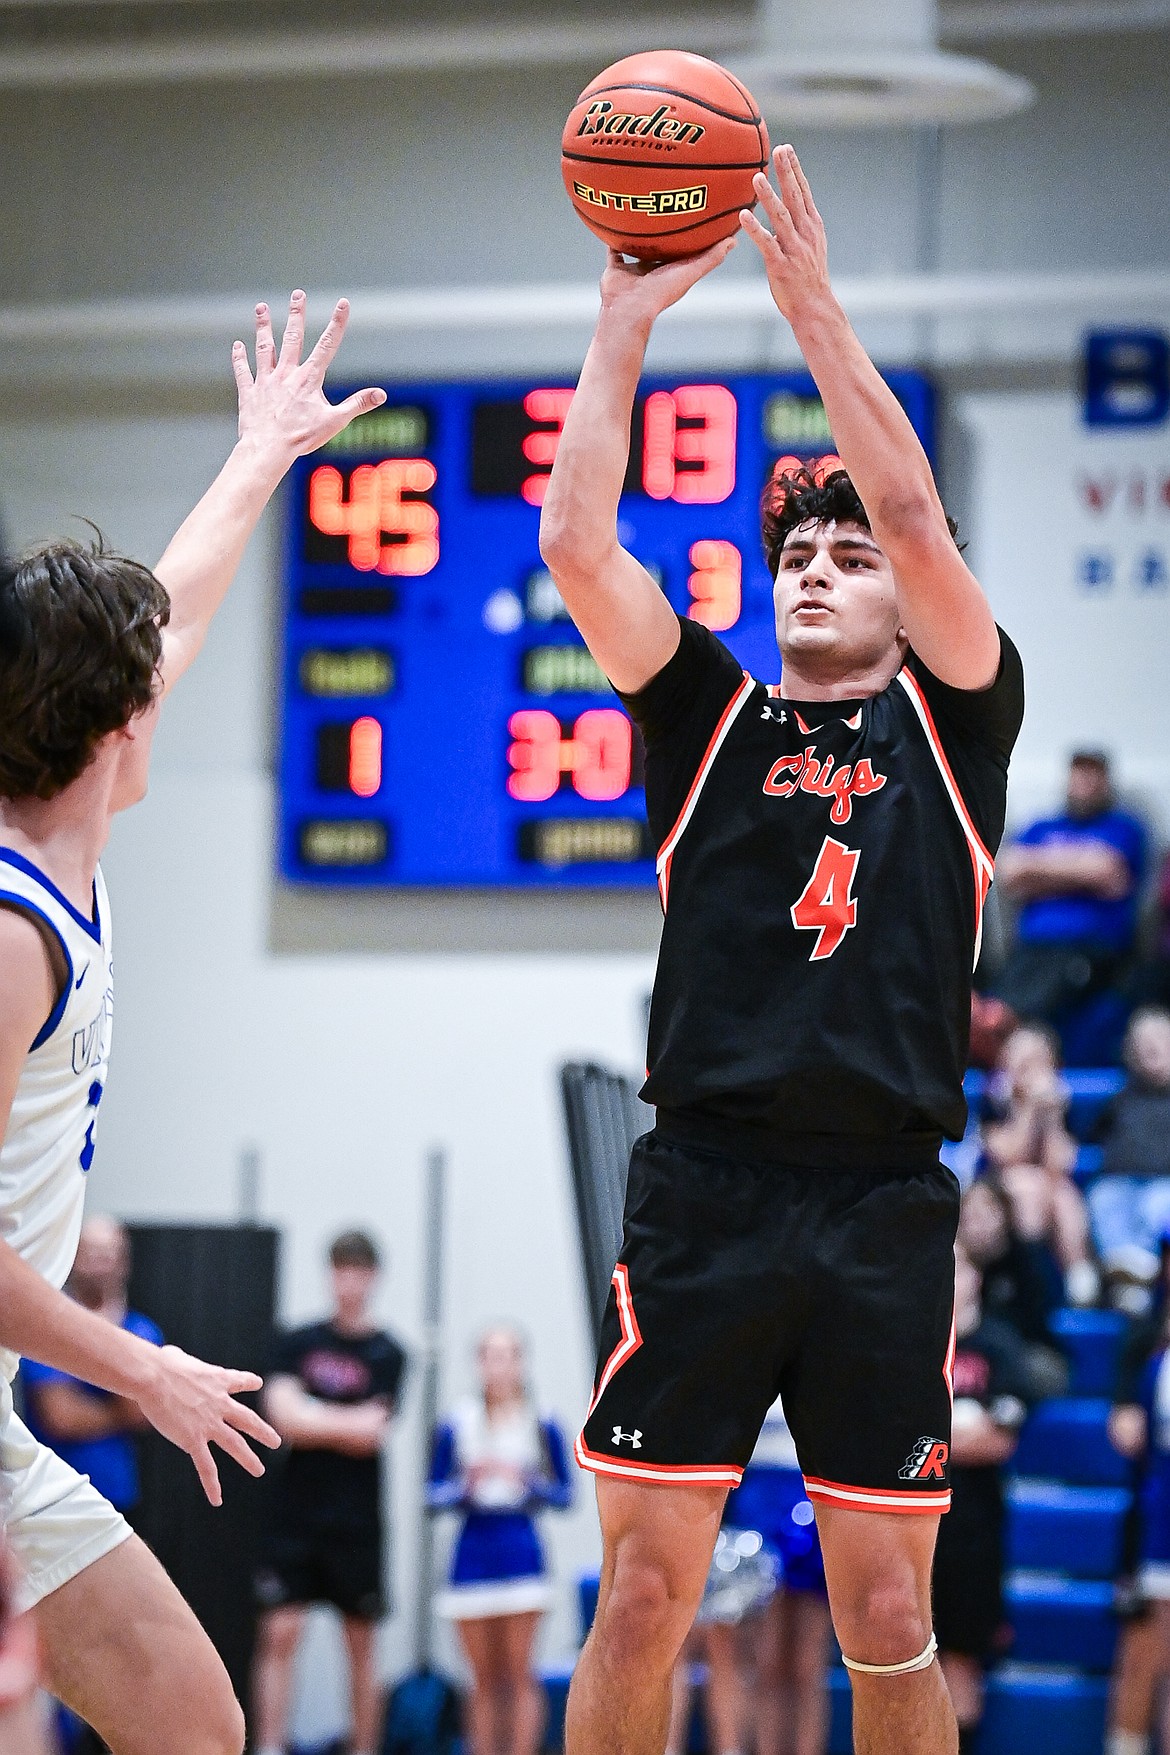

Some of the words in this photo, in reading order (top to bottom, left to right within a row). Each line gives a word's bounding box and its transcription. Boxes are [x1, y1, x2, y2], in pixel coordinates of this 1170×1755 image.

[577, 100, 706, 146] Baden
[592, 138, 674, 152] PERFECTION
[659, 189, 703, 213] PRO
[309, 459, 440, 576] 45
[687, 540, 742, 631] 3
[349, 716, 382, 797] 1
[790, 835, 861, 961] 4
[911, 1440, 949, 1480] R
